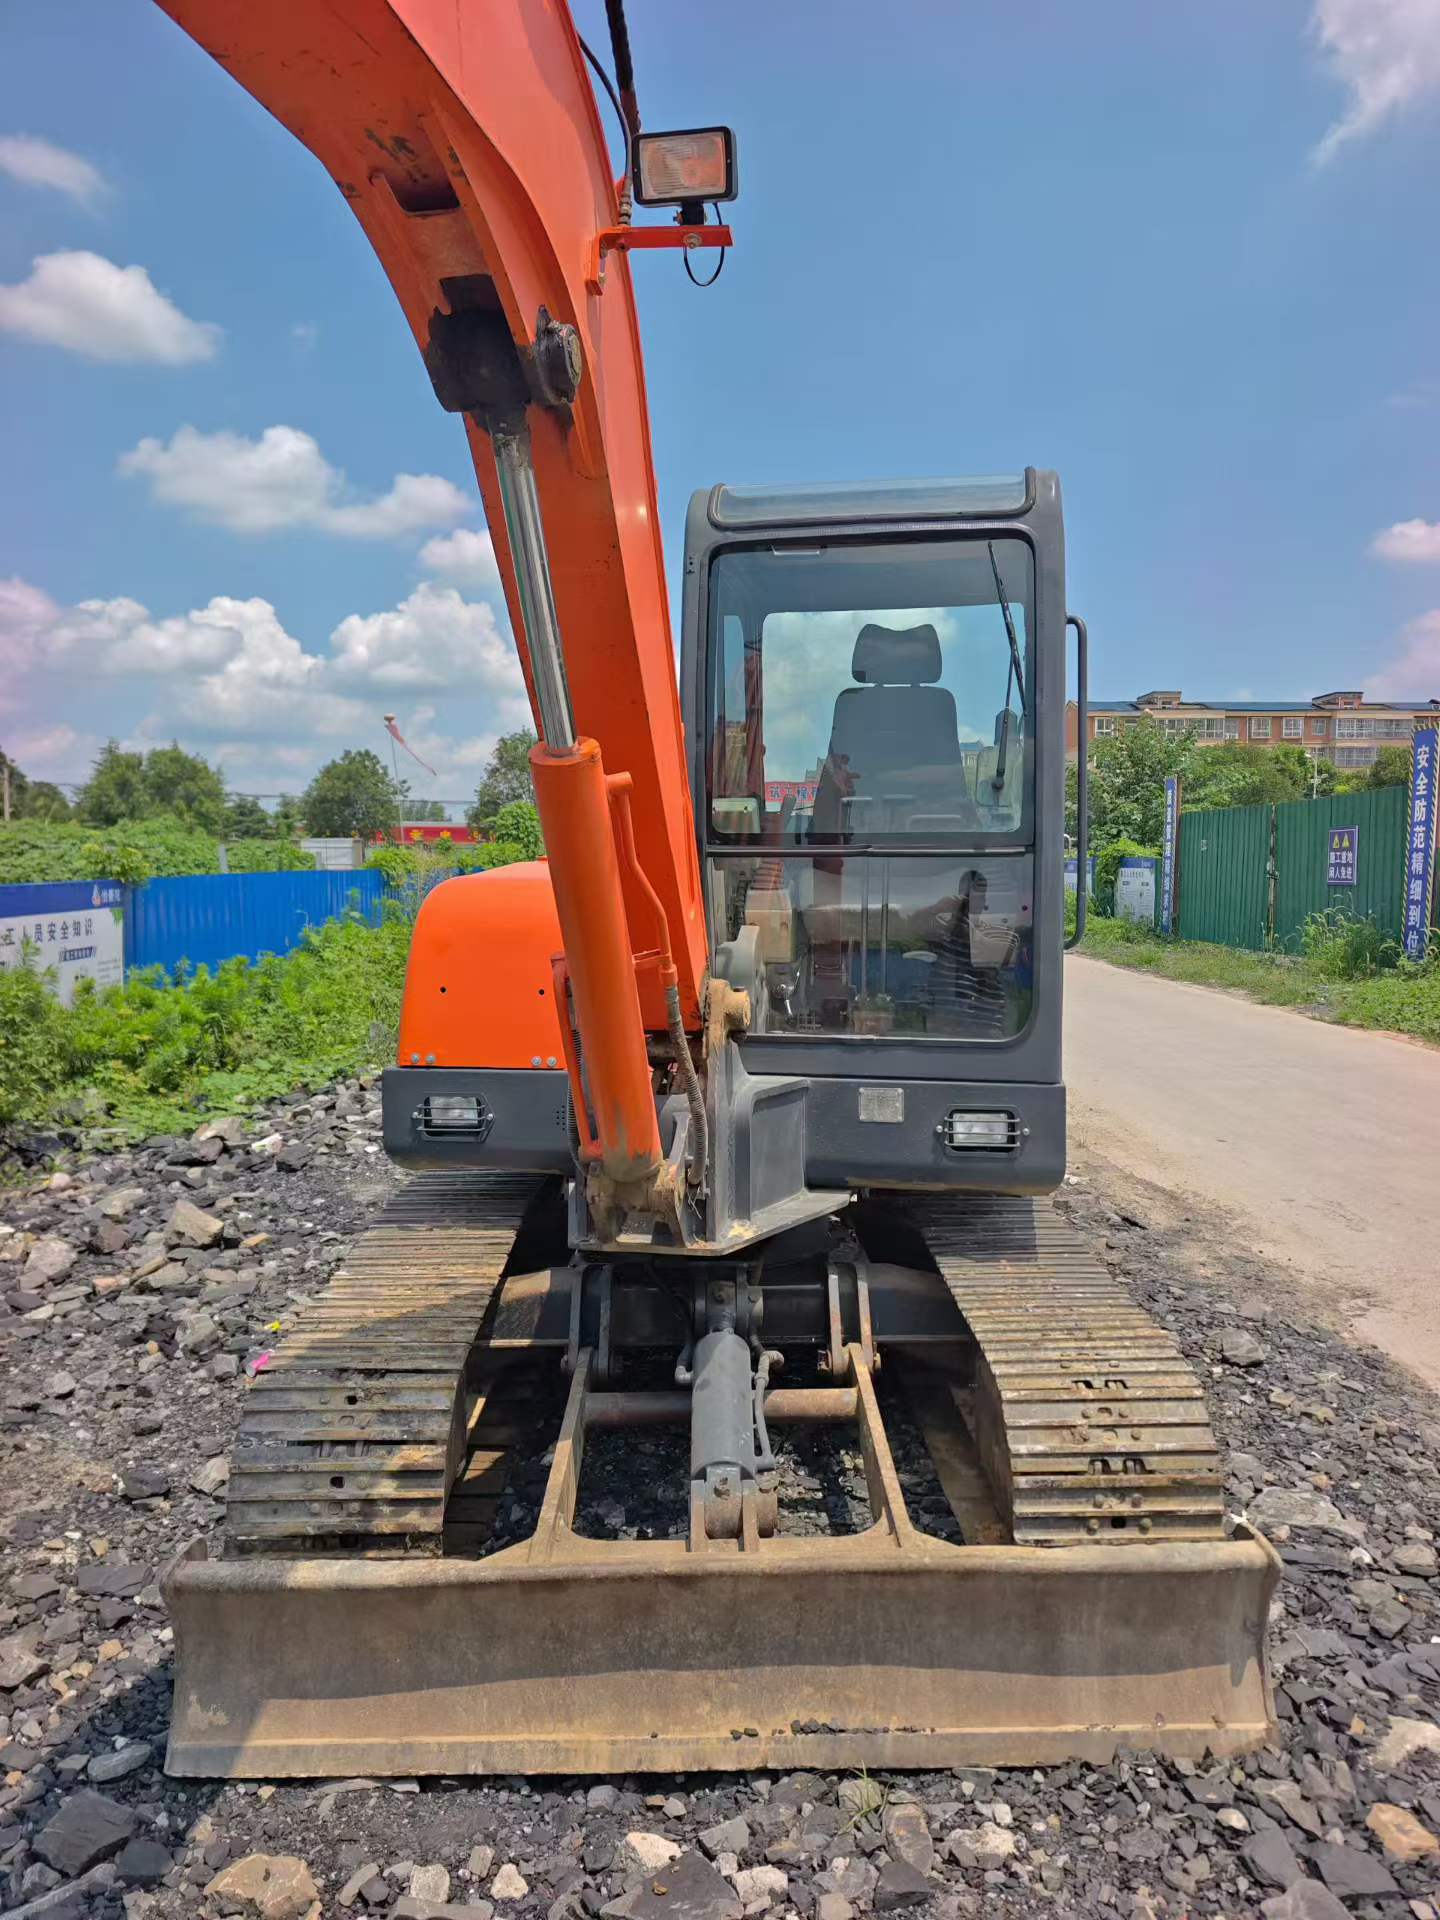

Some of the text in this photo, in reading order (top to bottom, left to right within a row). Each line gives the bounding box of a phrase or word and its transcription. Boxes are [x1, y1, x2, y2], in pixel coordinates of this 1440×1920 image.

[1406, 744, 1430, 954] 安全防范精细到位
